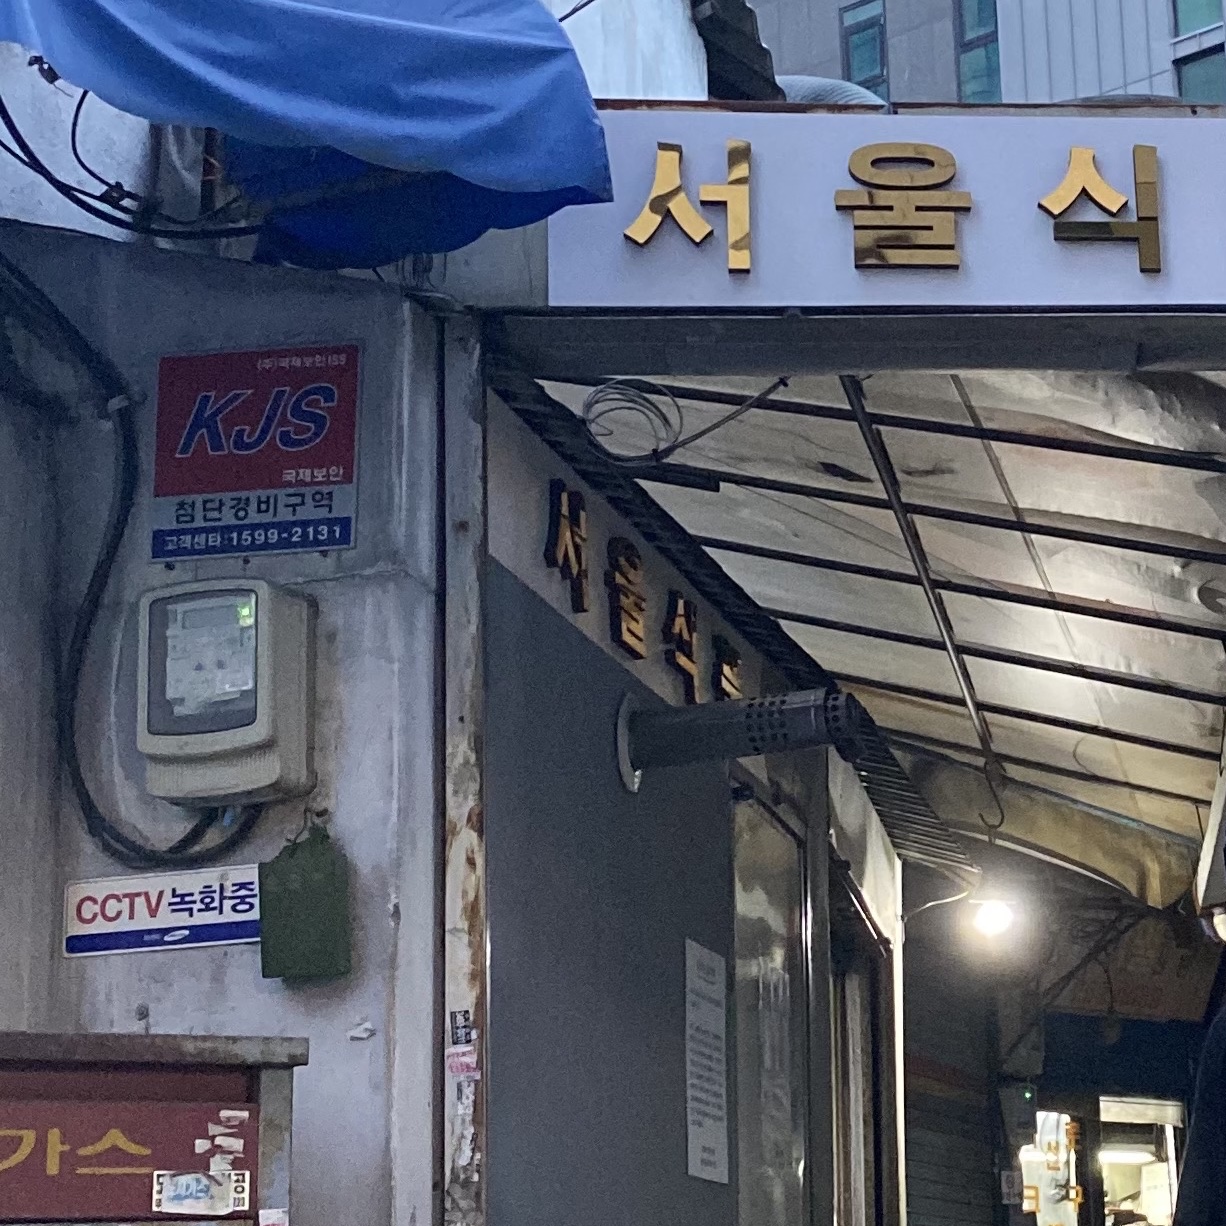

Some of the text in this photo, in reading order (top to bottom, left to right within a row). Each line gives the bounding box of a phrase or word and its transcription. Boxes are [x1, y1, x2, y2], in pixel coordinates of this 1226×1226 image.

[175, 383, 337, 458] KJS
[282, 466, 344, 483] 국제보안
[175, 490, 334, 524] 첨단경비구역
[75, 889, 165, 925] CCTV
[168, 881, 258, 918] 녹화중
[0, 1127, 154, 1176] 가스
